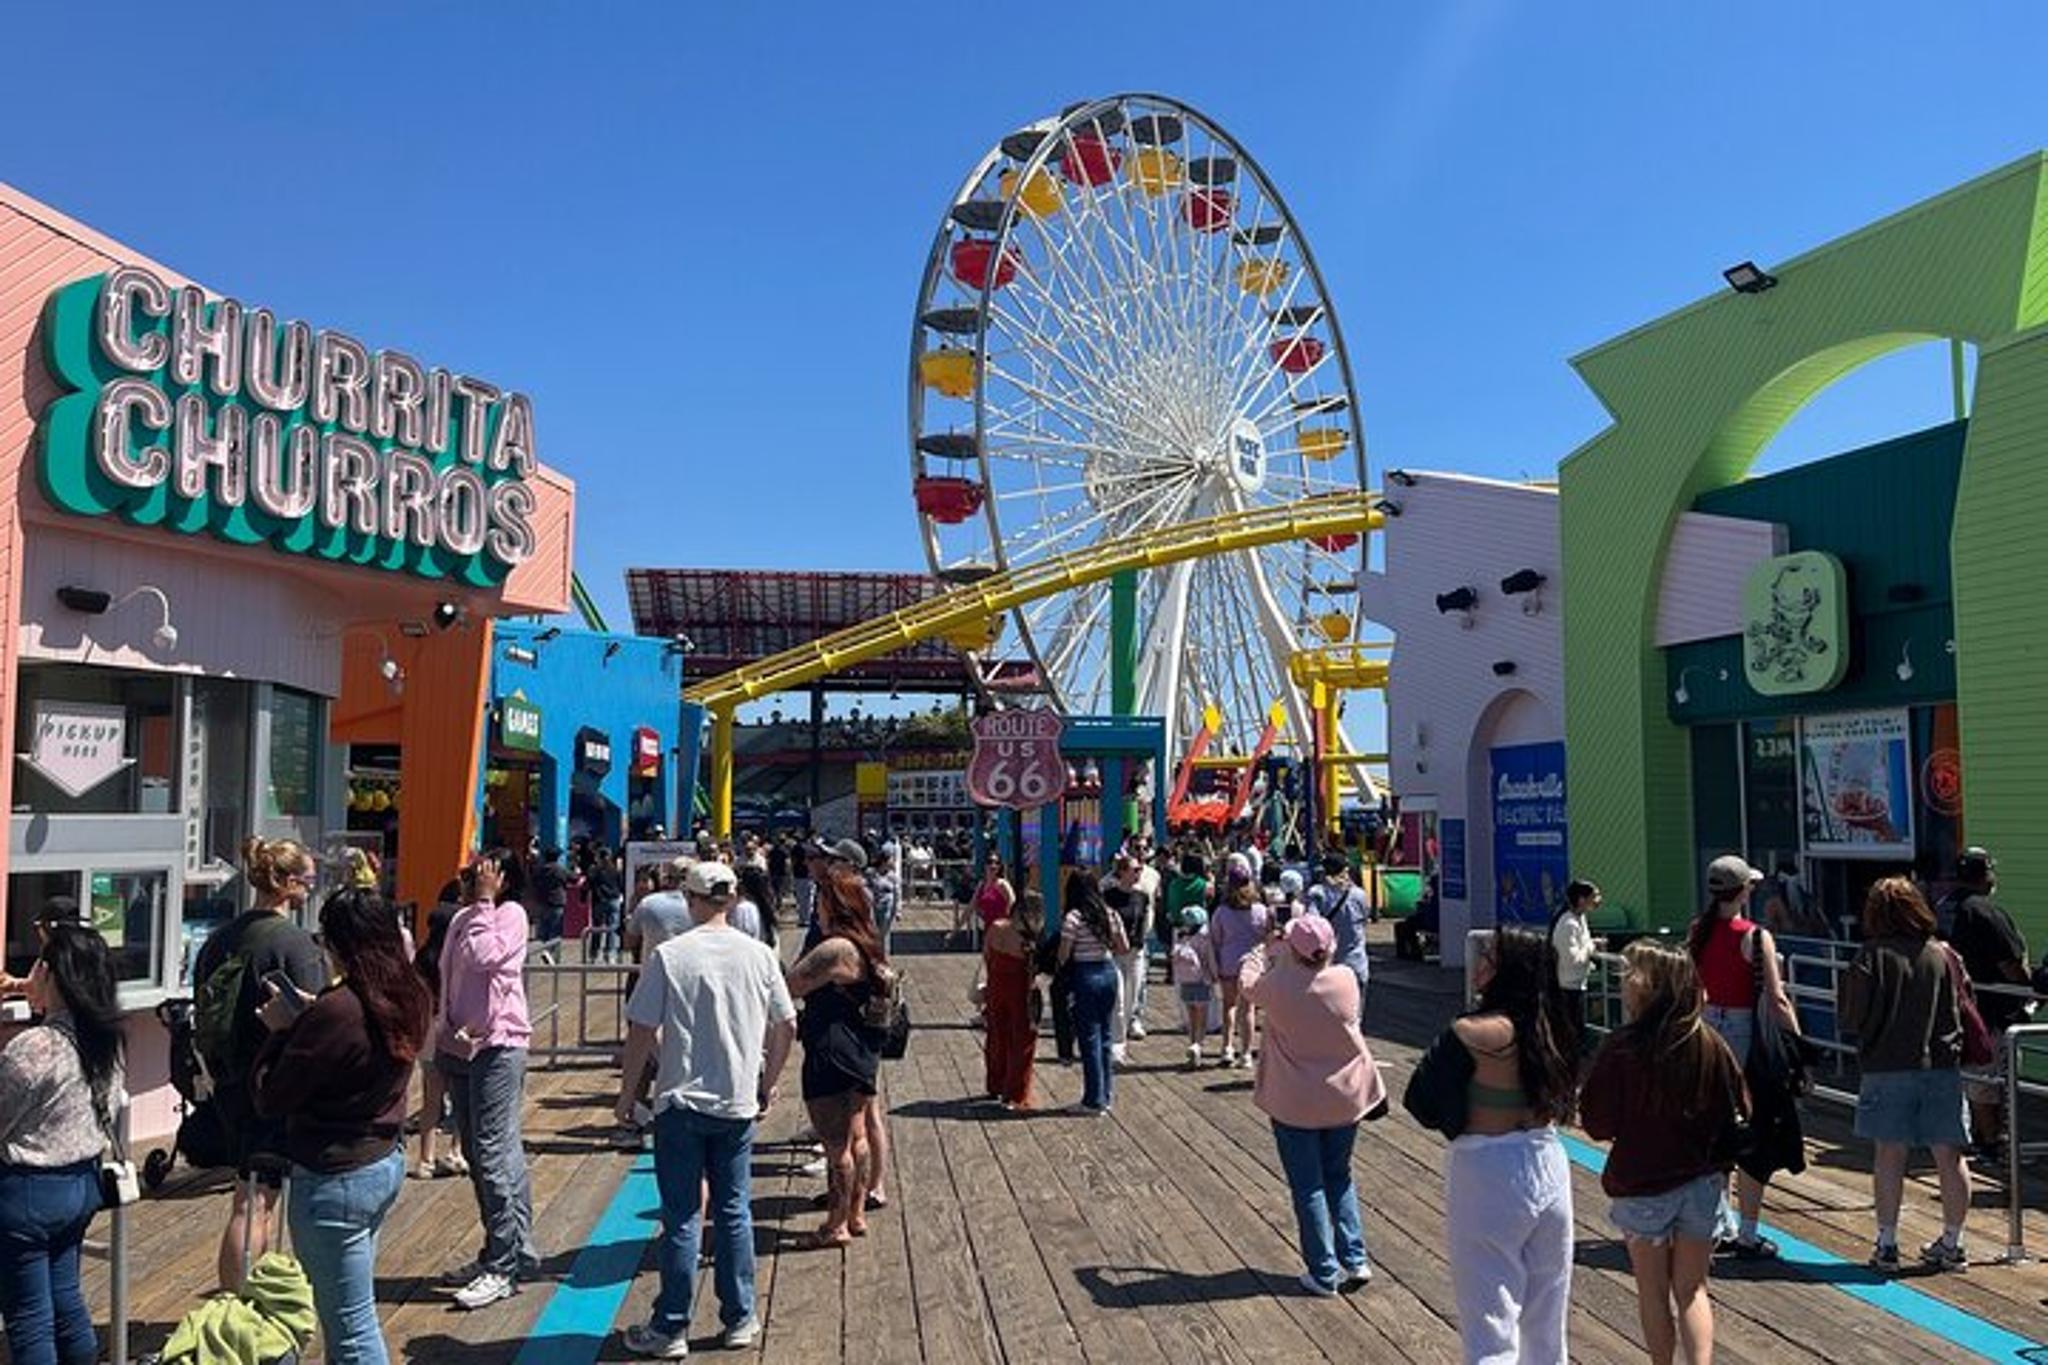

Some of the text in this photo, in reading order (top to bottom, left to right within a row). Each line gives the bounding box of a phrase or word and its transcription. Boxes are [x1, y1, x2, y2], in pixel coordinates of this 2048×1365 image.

[100, 265, 538, 478] CHURRITA
[97, 378, 536, 565] CHURROS
[40, 721, 119, 742] PICKUP
[984, 716, 1046, 736] ROUTE
[62, 744, 99, 758] HERE
[987, 760, 1047, 799] 66
